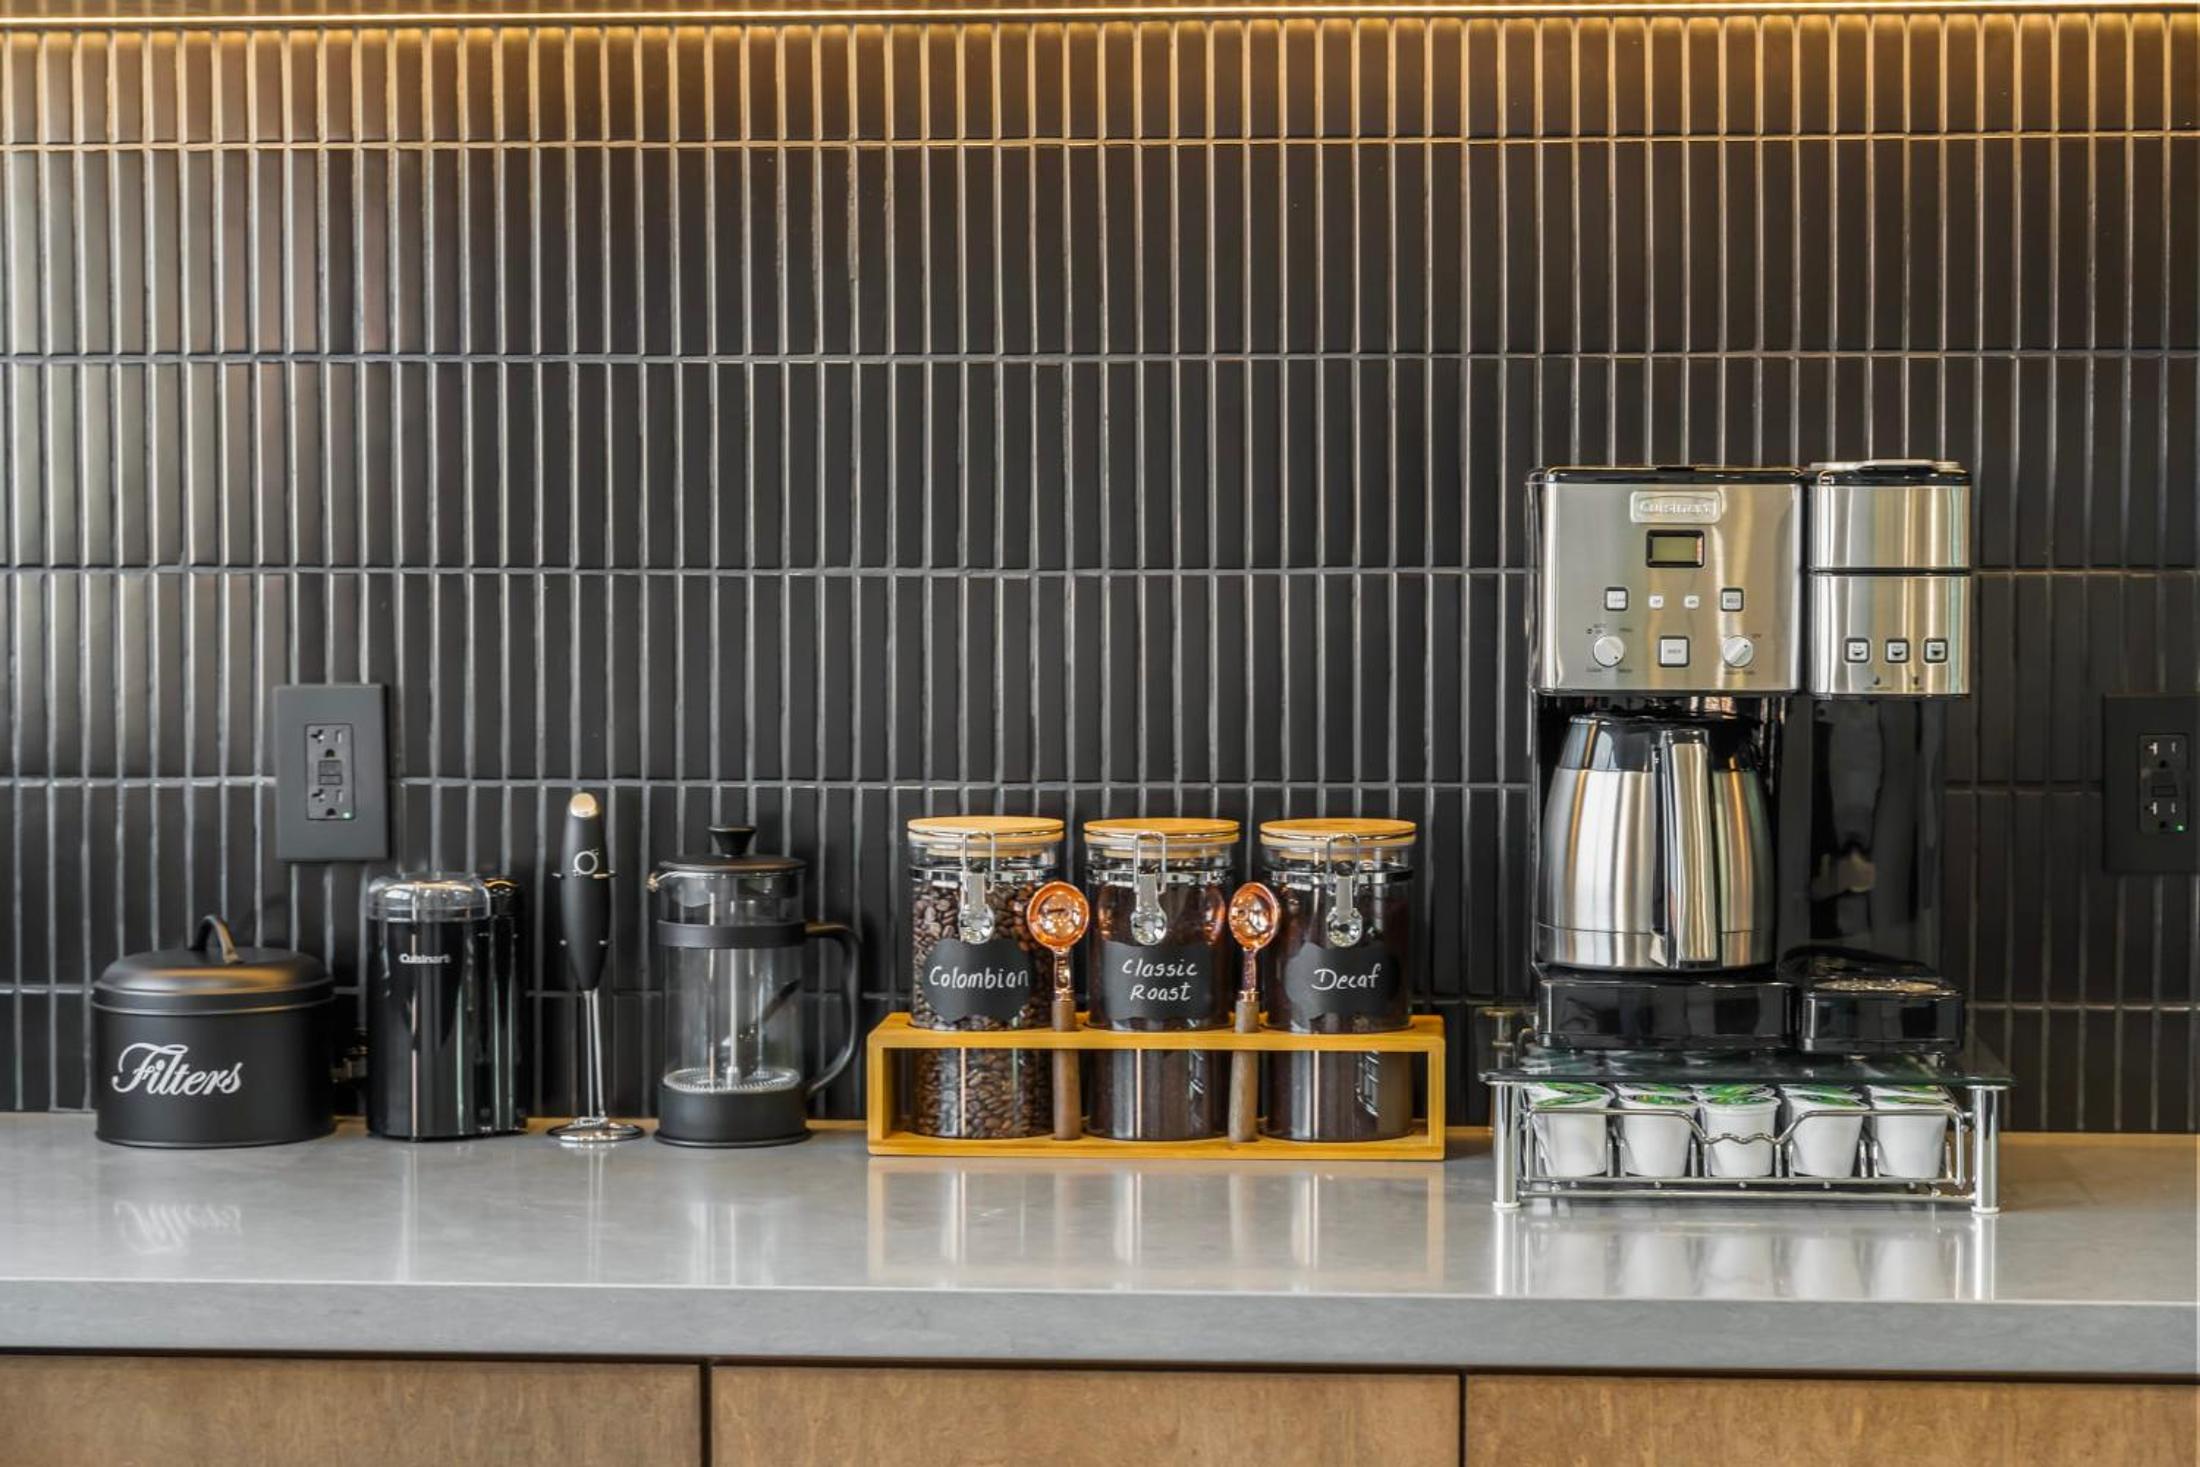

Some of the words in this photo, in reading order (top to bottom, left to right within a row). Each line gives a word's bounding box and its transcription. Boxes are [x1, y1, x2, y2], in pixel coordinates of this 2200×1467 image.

[399, 952, 451, 965] Cuisinart
[1121, 957, 1198, 978] Classic
[929, 965, 1030, 990] Colombian
[1311, 962, 1382, 991] Decaf
[1129, 981, 1193, 1002] Roast
[111, 1042, 244, 1096] Filters
